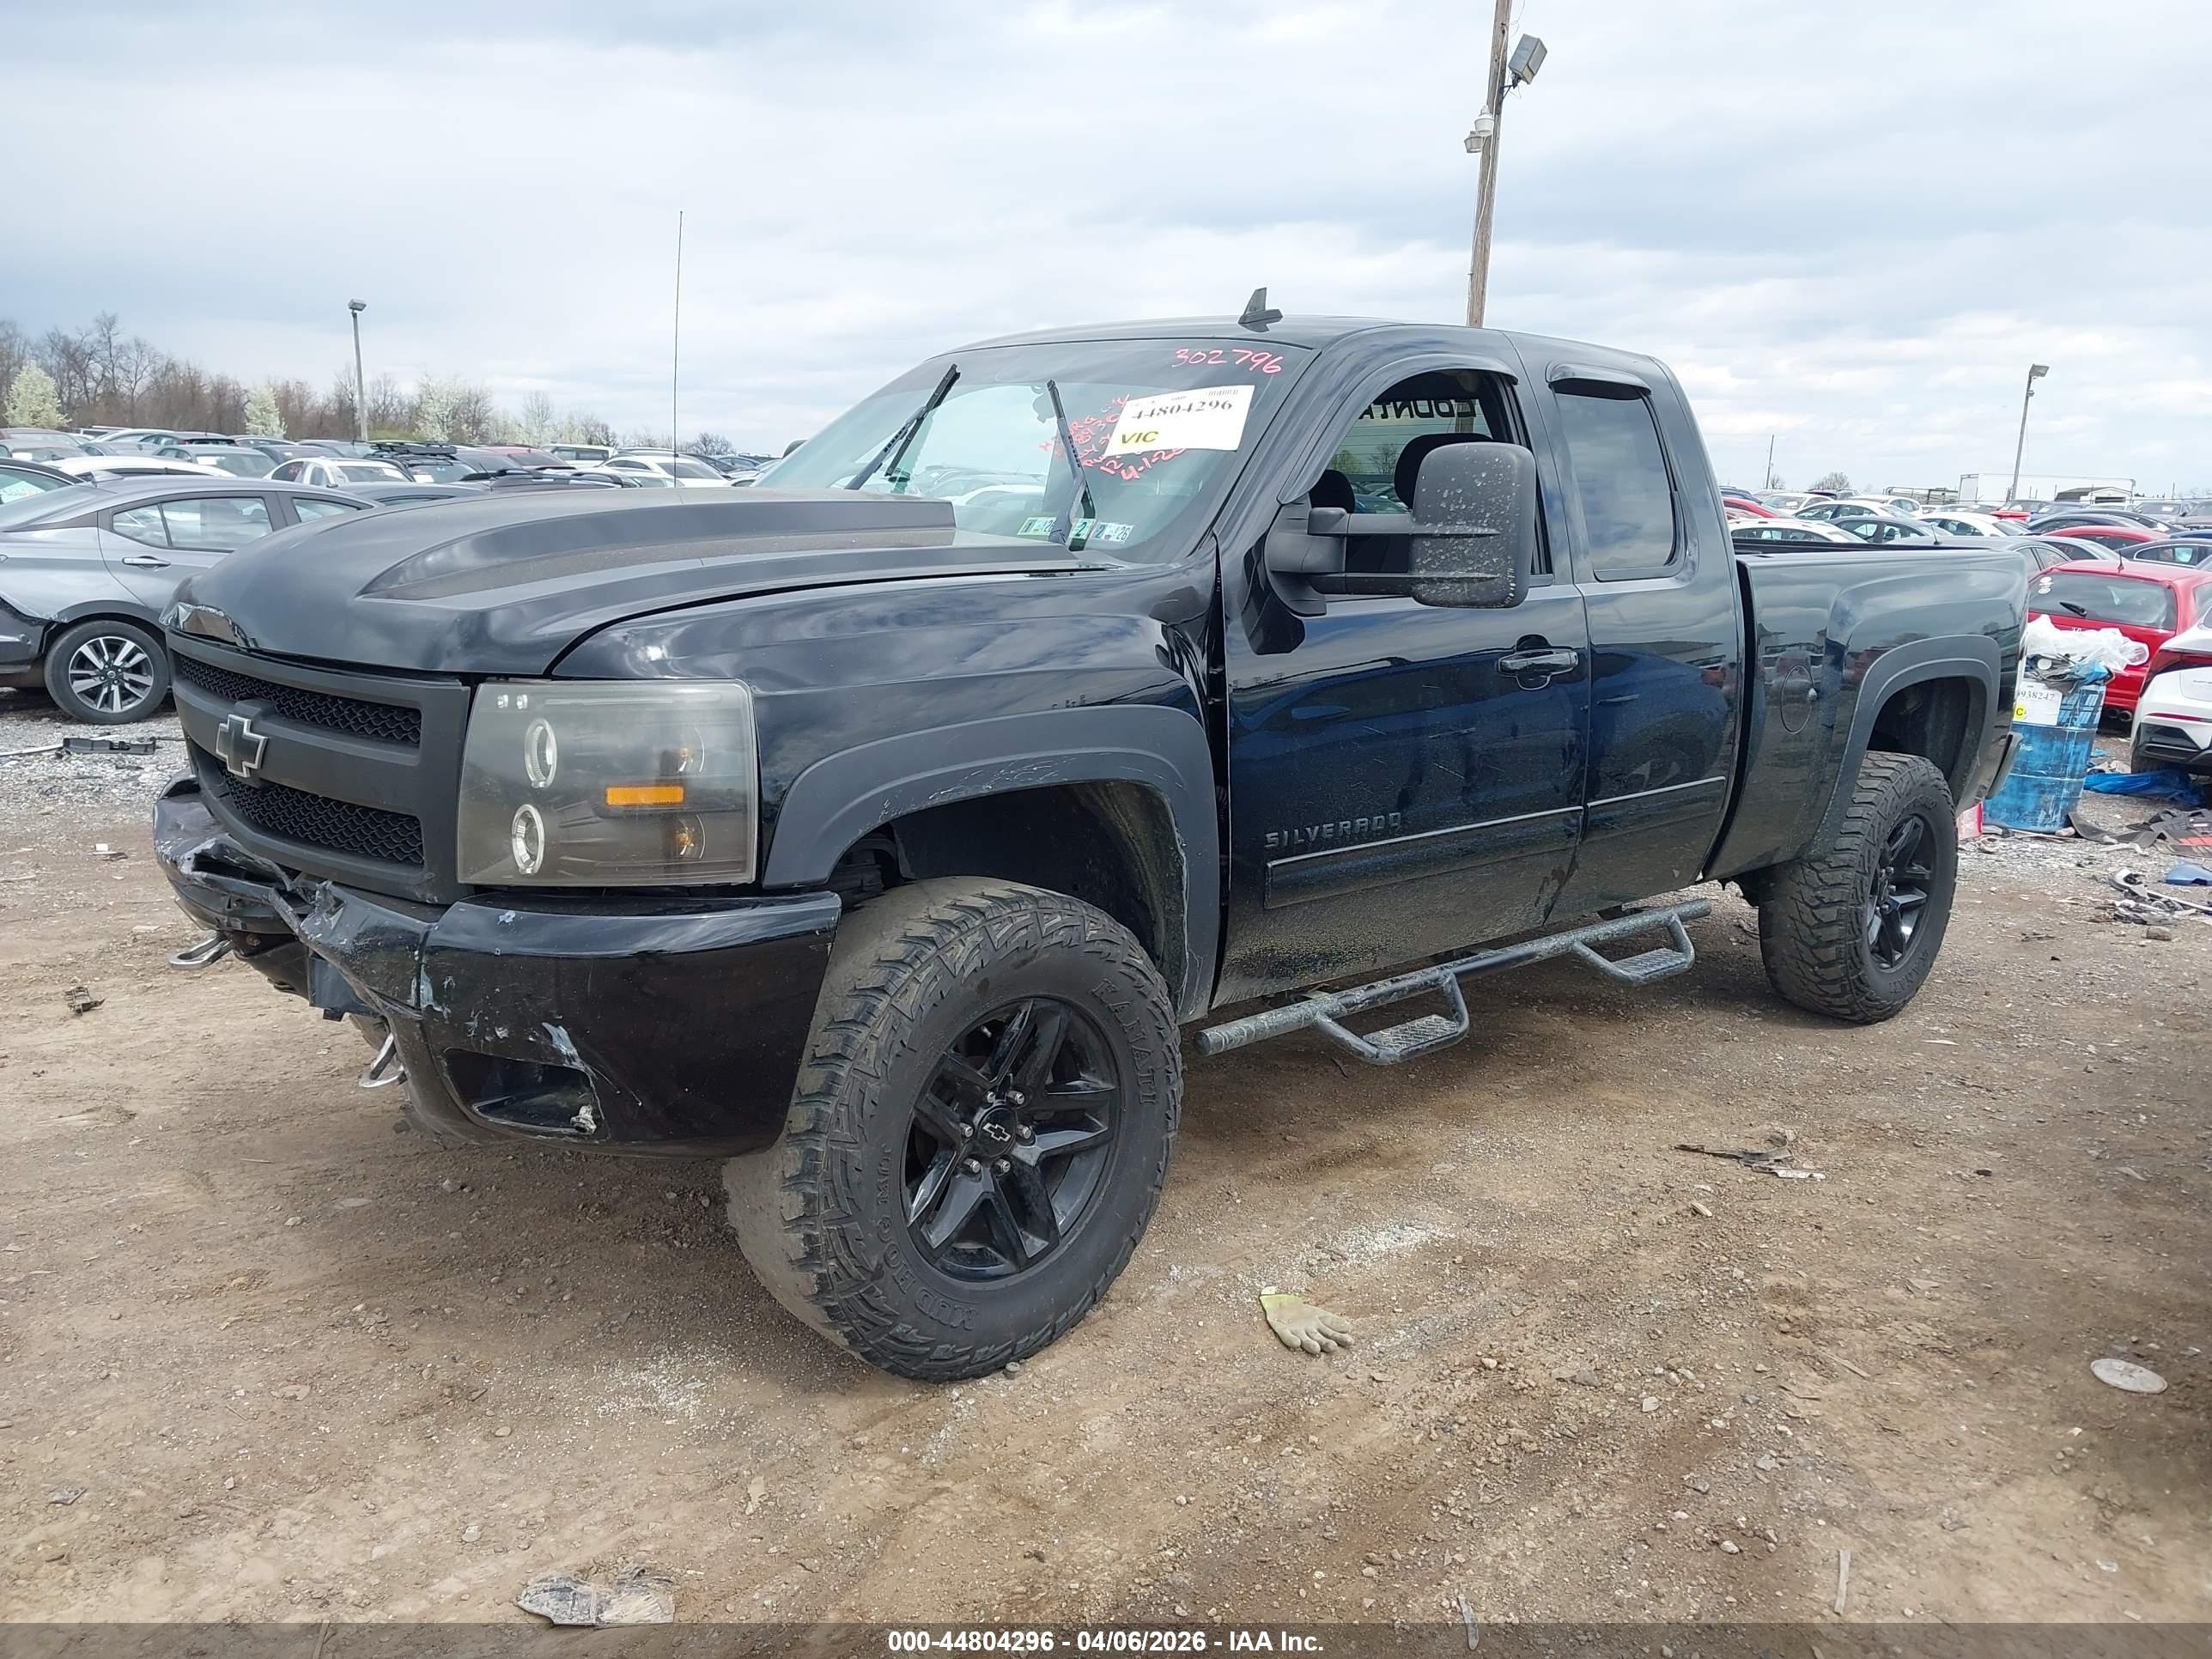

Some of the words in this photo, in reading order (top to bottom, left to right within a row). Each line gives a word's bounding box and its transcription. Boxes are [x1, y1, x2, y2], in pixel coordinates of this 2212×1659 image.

[1171, 348, 1284, 374] 302796
[1132, 399, 1233, 420] 44804296
[1121, 431, 1158, 445] VIC
[1264, 812, 1401, 849] SILVERADO
[1091, 977, 1157, 1104] KANATI
[878, 1215, 916, 1295] HOG
